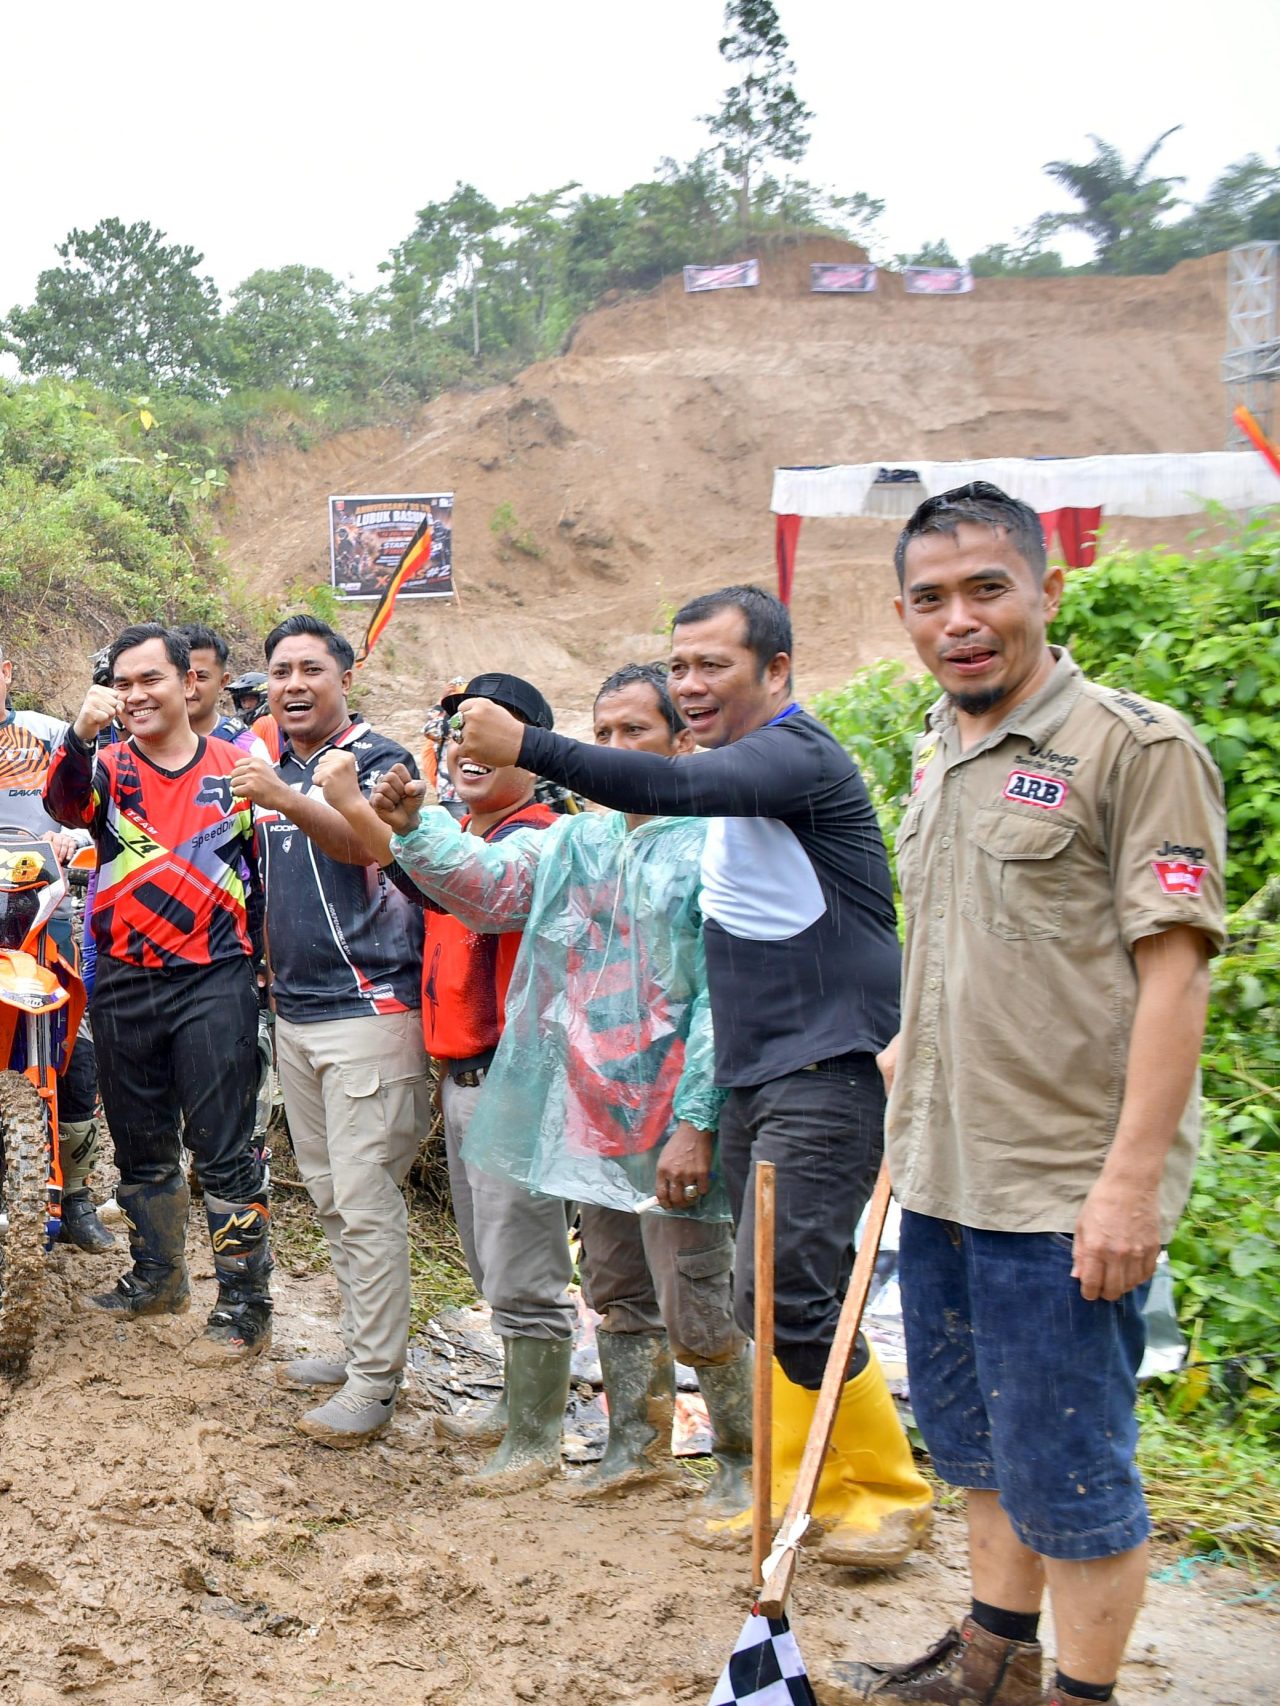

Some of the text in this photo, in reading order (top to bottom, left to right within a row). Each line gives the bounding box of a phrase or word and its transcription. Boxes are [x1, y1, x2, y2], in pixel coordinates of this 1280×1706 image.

[1040, 749, 1079, 767] Jeep
[9, 789, 42, 797] DAKAR
[1008, 775, 1060, 805] ARB
[127, 810, 159, 835] TEAM
[128, 835, 159, 854] 74
[1156, 840, 1206, 862] Jeep
